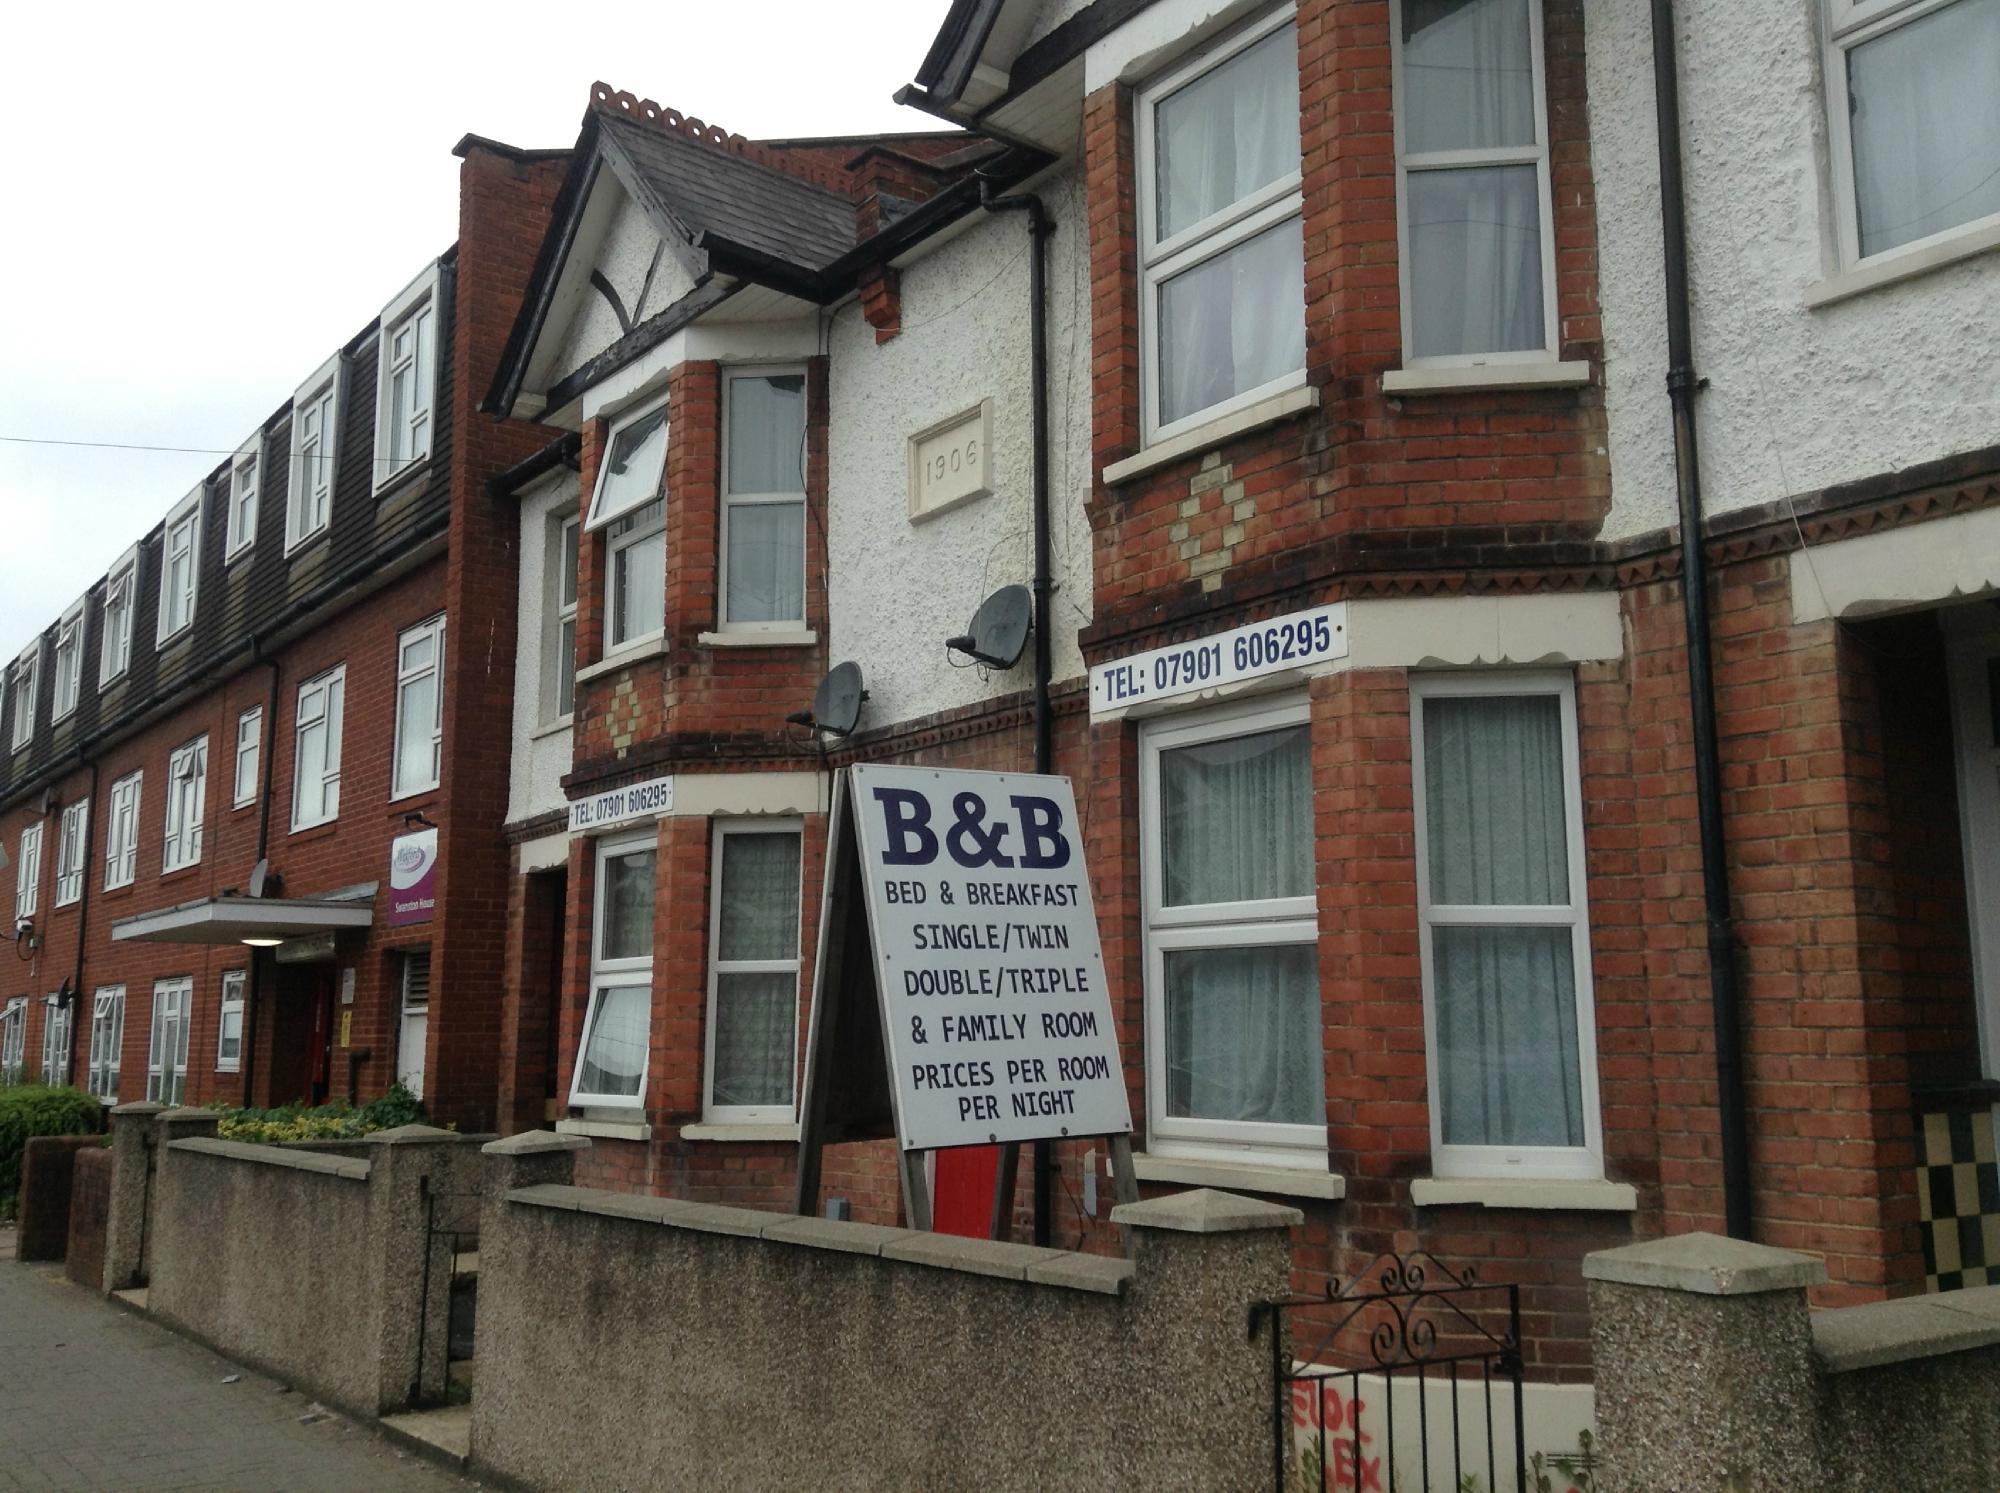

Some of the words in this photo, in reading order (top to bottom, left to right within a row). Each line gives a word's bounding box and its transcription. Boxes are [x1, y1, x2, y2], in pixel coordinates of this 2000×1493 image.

[925, 440, 977, 486] 1906
[1104, 664, 1145, 702] TEL:
[1154, 643, 1221, 691] 07901
[1234, 615, 1331, 672] 606295
[574, 801, 593, 826] TEL:
[596, 793, 624, 820] 07901
[628, 783, 667, 813] 606295
[872, 787, 1071, 870] B&B
[885, 880, 927, 904] BED
[939, 880, 955, 905] &
[966, 882, 1078, 906] BREAKFAST
[912, 923, 1070, 953] SINGLE/TWIN
[903, 966, 1089, 998] DOUBLE/TRIPLE
[911, 1015, 928, 1044] &
[942, 1013, 1026, 1042] FAMILY
[1041, 1011, 1098, 1039] ROOM
[912, 1061, 995, 1090] PRICES
[1006, 1058, 1047, 1084] PER
[1058, 1055, 1110, 1081] ROOM
[958, 1095, 1000, 1121] PER
[1011, 1089, 1075, 1118] NIGHT
